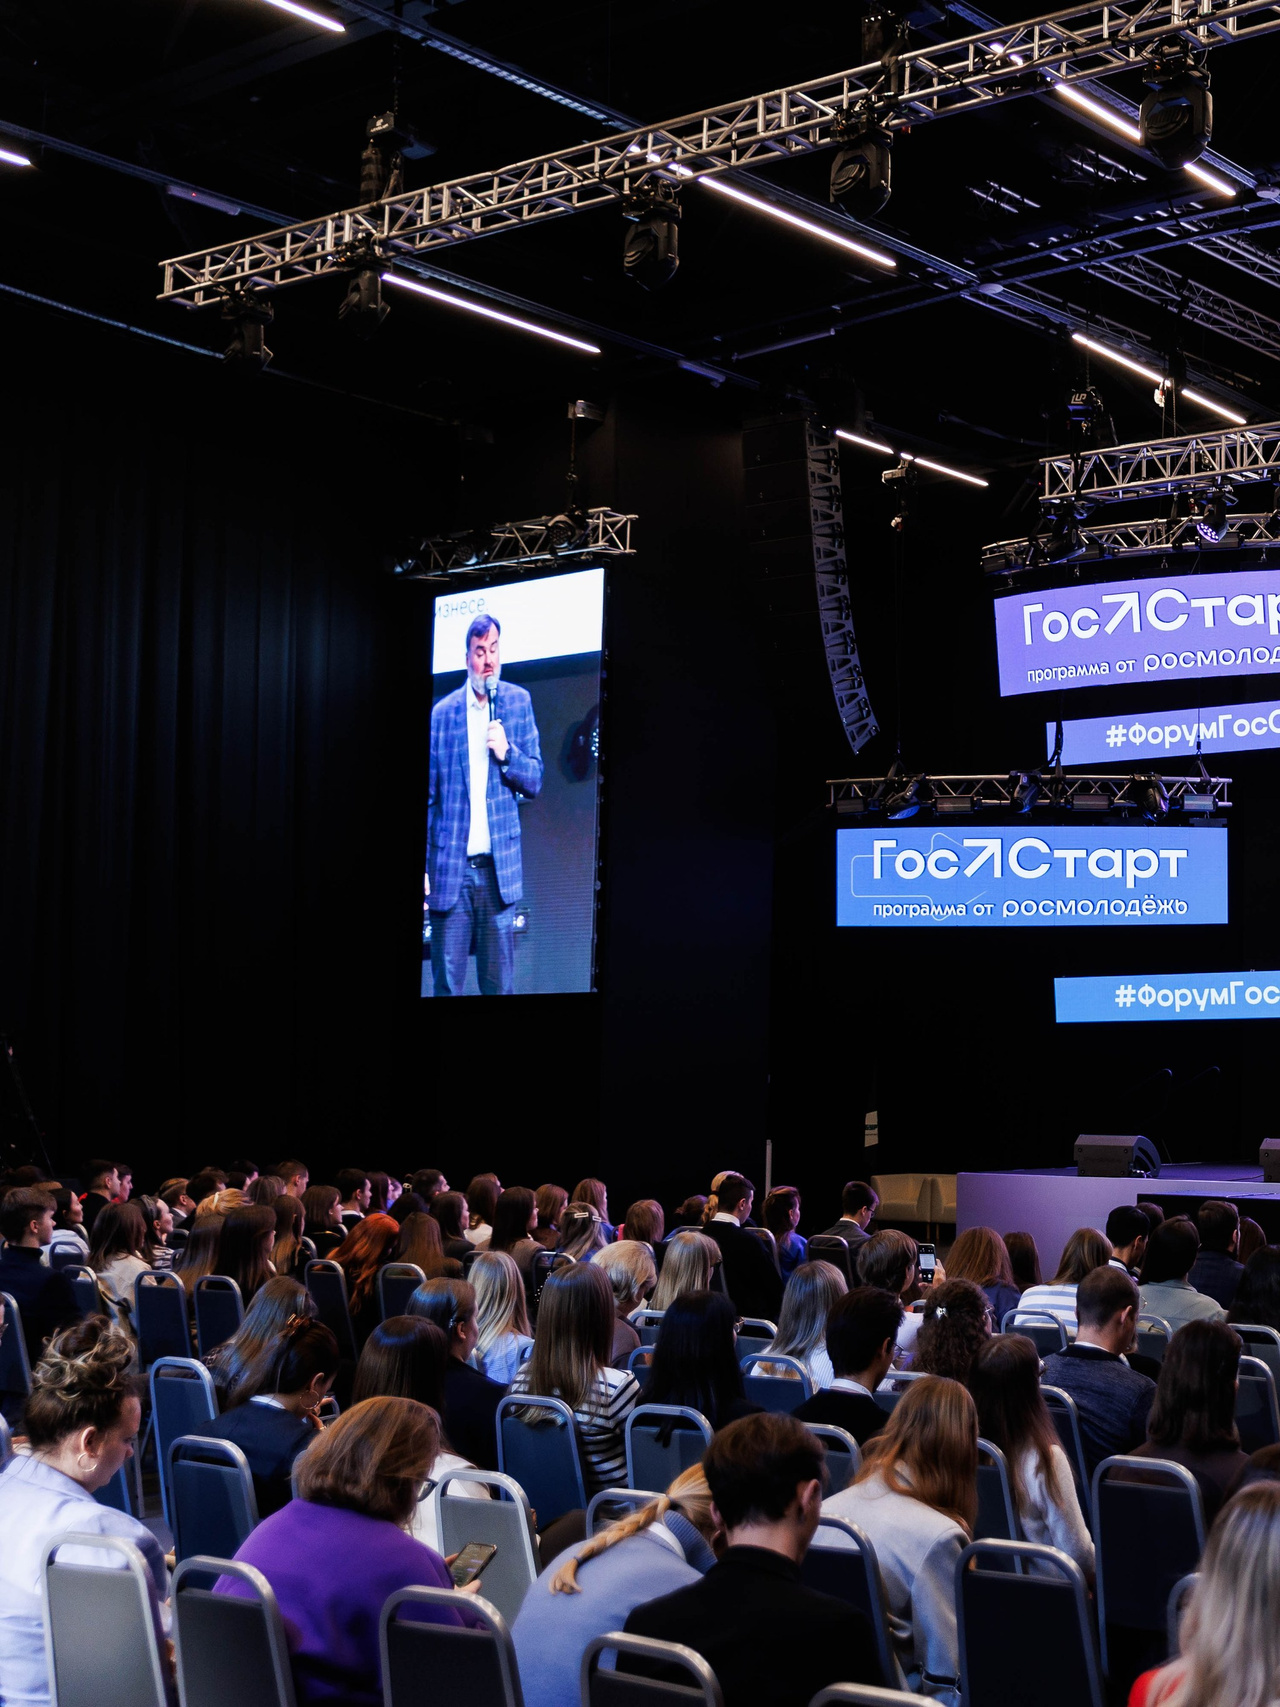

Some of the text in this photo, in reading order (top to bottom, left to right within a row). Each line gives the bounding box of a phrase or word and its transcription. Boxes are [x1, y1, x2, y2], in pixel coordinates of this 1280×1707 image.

[1027, 662, 1110, 684] программа
[1115, 660, 1137, 673] от
[873, 895, 1188, 919] программа от росмолодёжь
